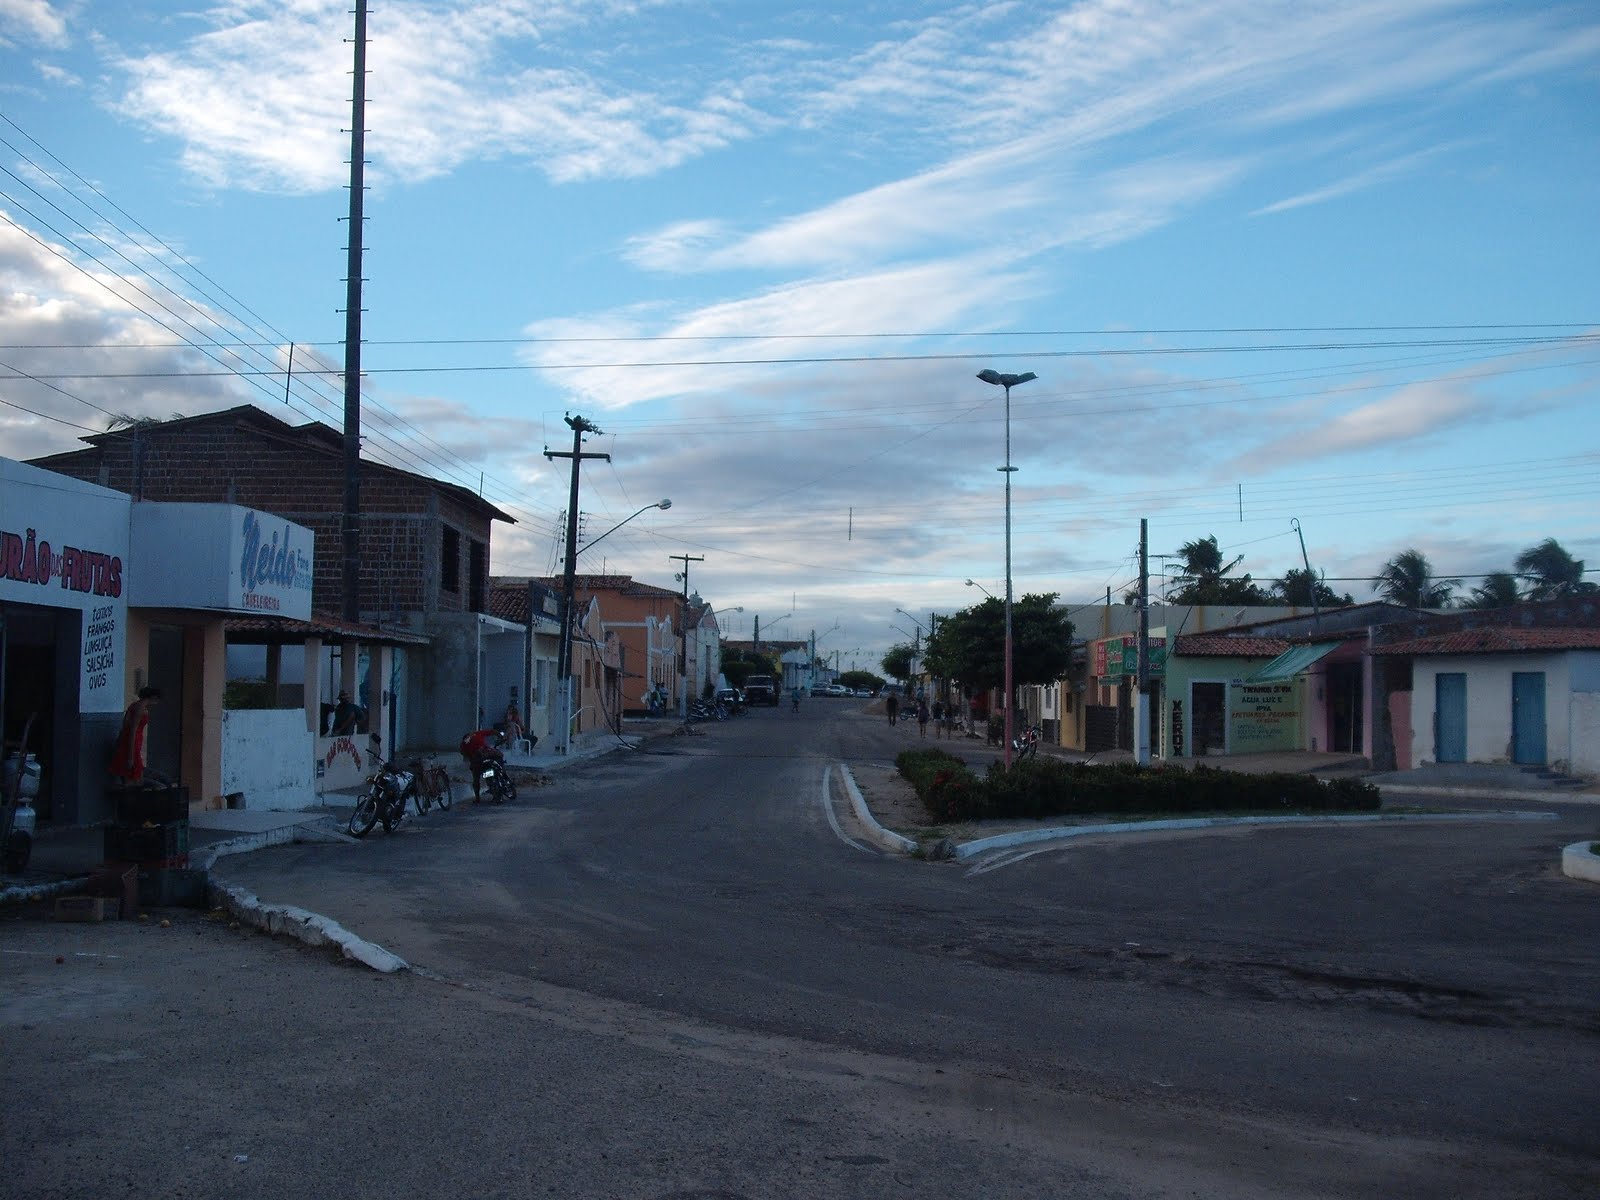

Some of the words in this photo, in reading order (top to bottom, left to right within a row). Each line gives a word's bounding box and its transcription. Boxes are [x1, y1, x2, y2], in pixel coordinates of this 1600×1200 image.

[61, 545, 122, 598] FRUTAS
[87, 619, 114, 638] FRANGOS
[84, 635, 112, 655] LINGUIÇA
[86, 652, 114, 673] SALSICHA
[89, 673, 106, 690] OVOS
[1172, 700, 1183, 756] XEROX
